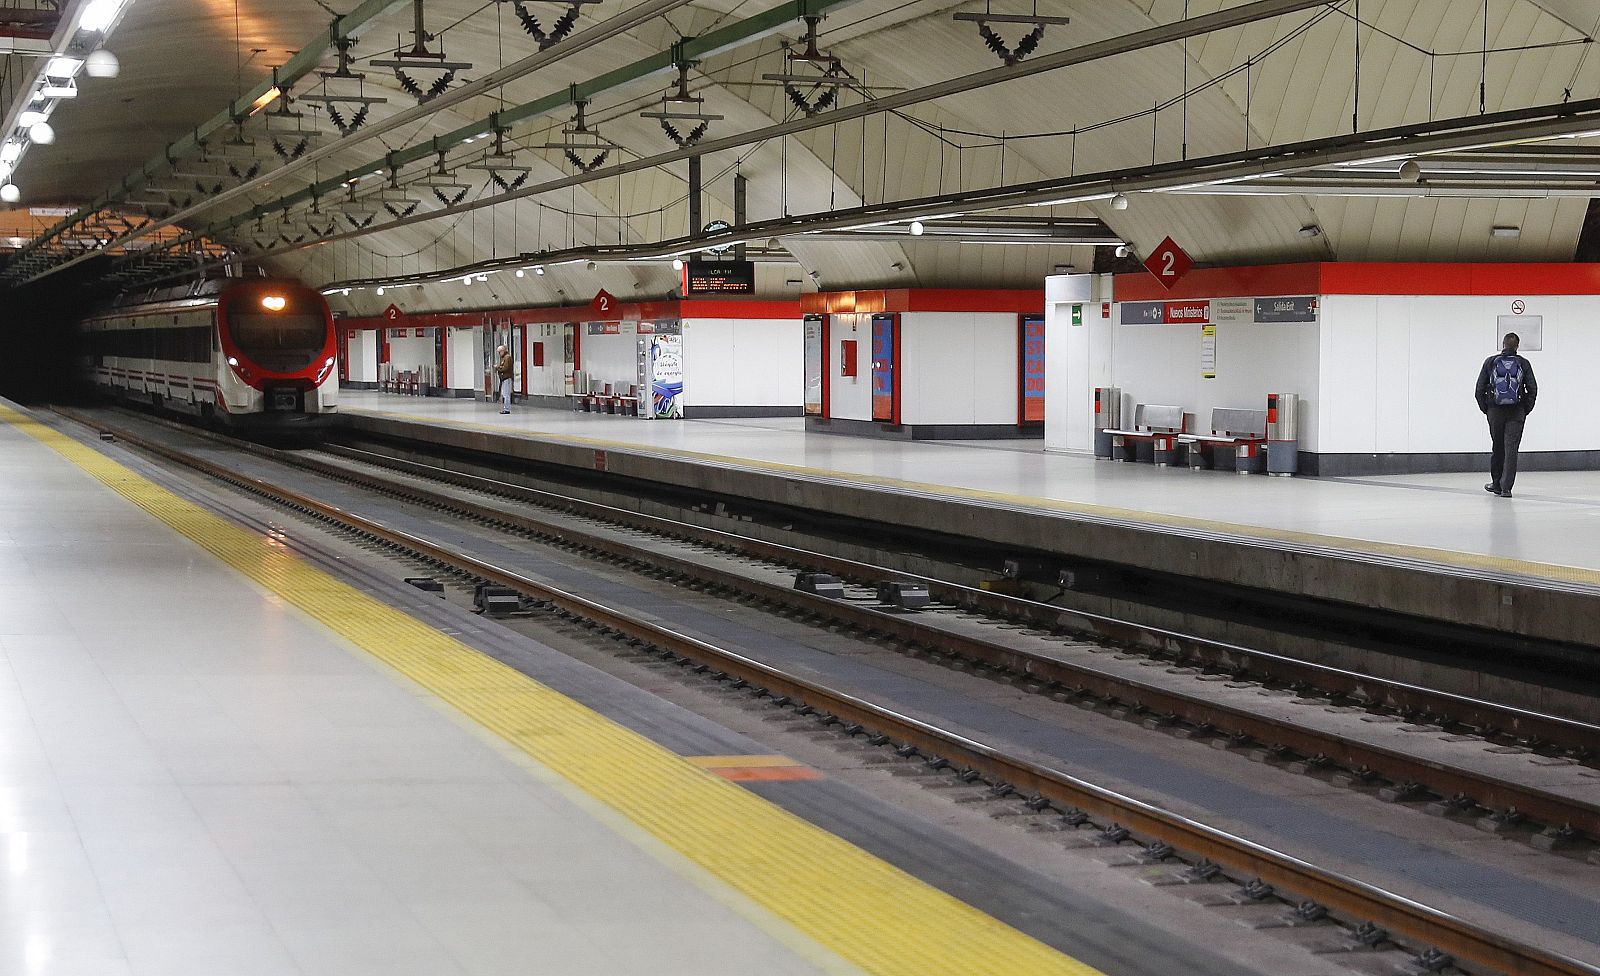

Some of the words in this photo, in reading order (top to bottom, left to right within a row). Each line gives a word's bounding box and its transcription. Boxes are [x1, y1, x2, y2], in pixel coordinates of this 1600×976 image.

[1162, 251, 1175, 276] 2
[600, 296, 609, 311] 2
[390, 309, 396, 319] 2
[1169, 306, 1183, 318] Nuevos
[1183, 306, 1203, 318] Ministerios
